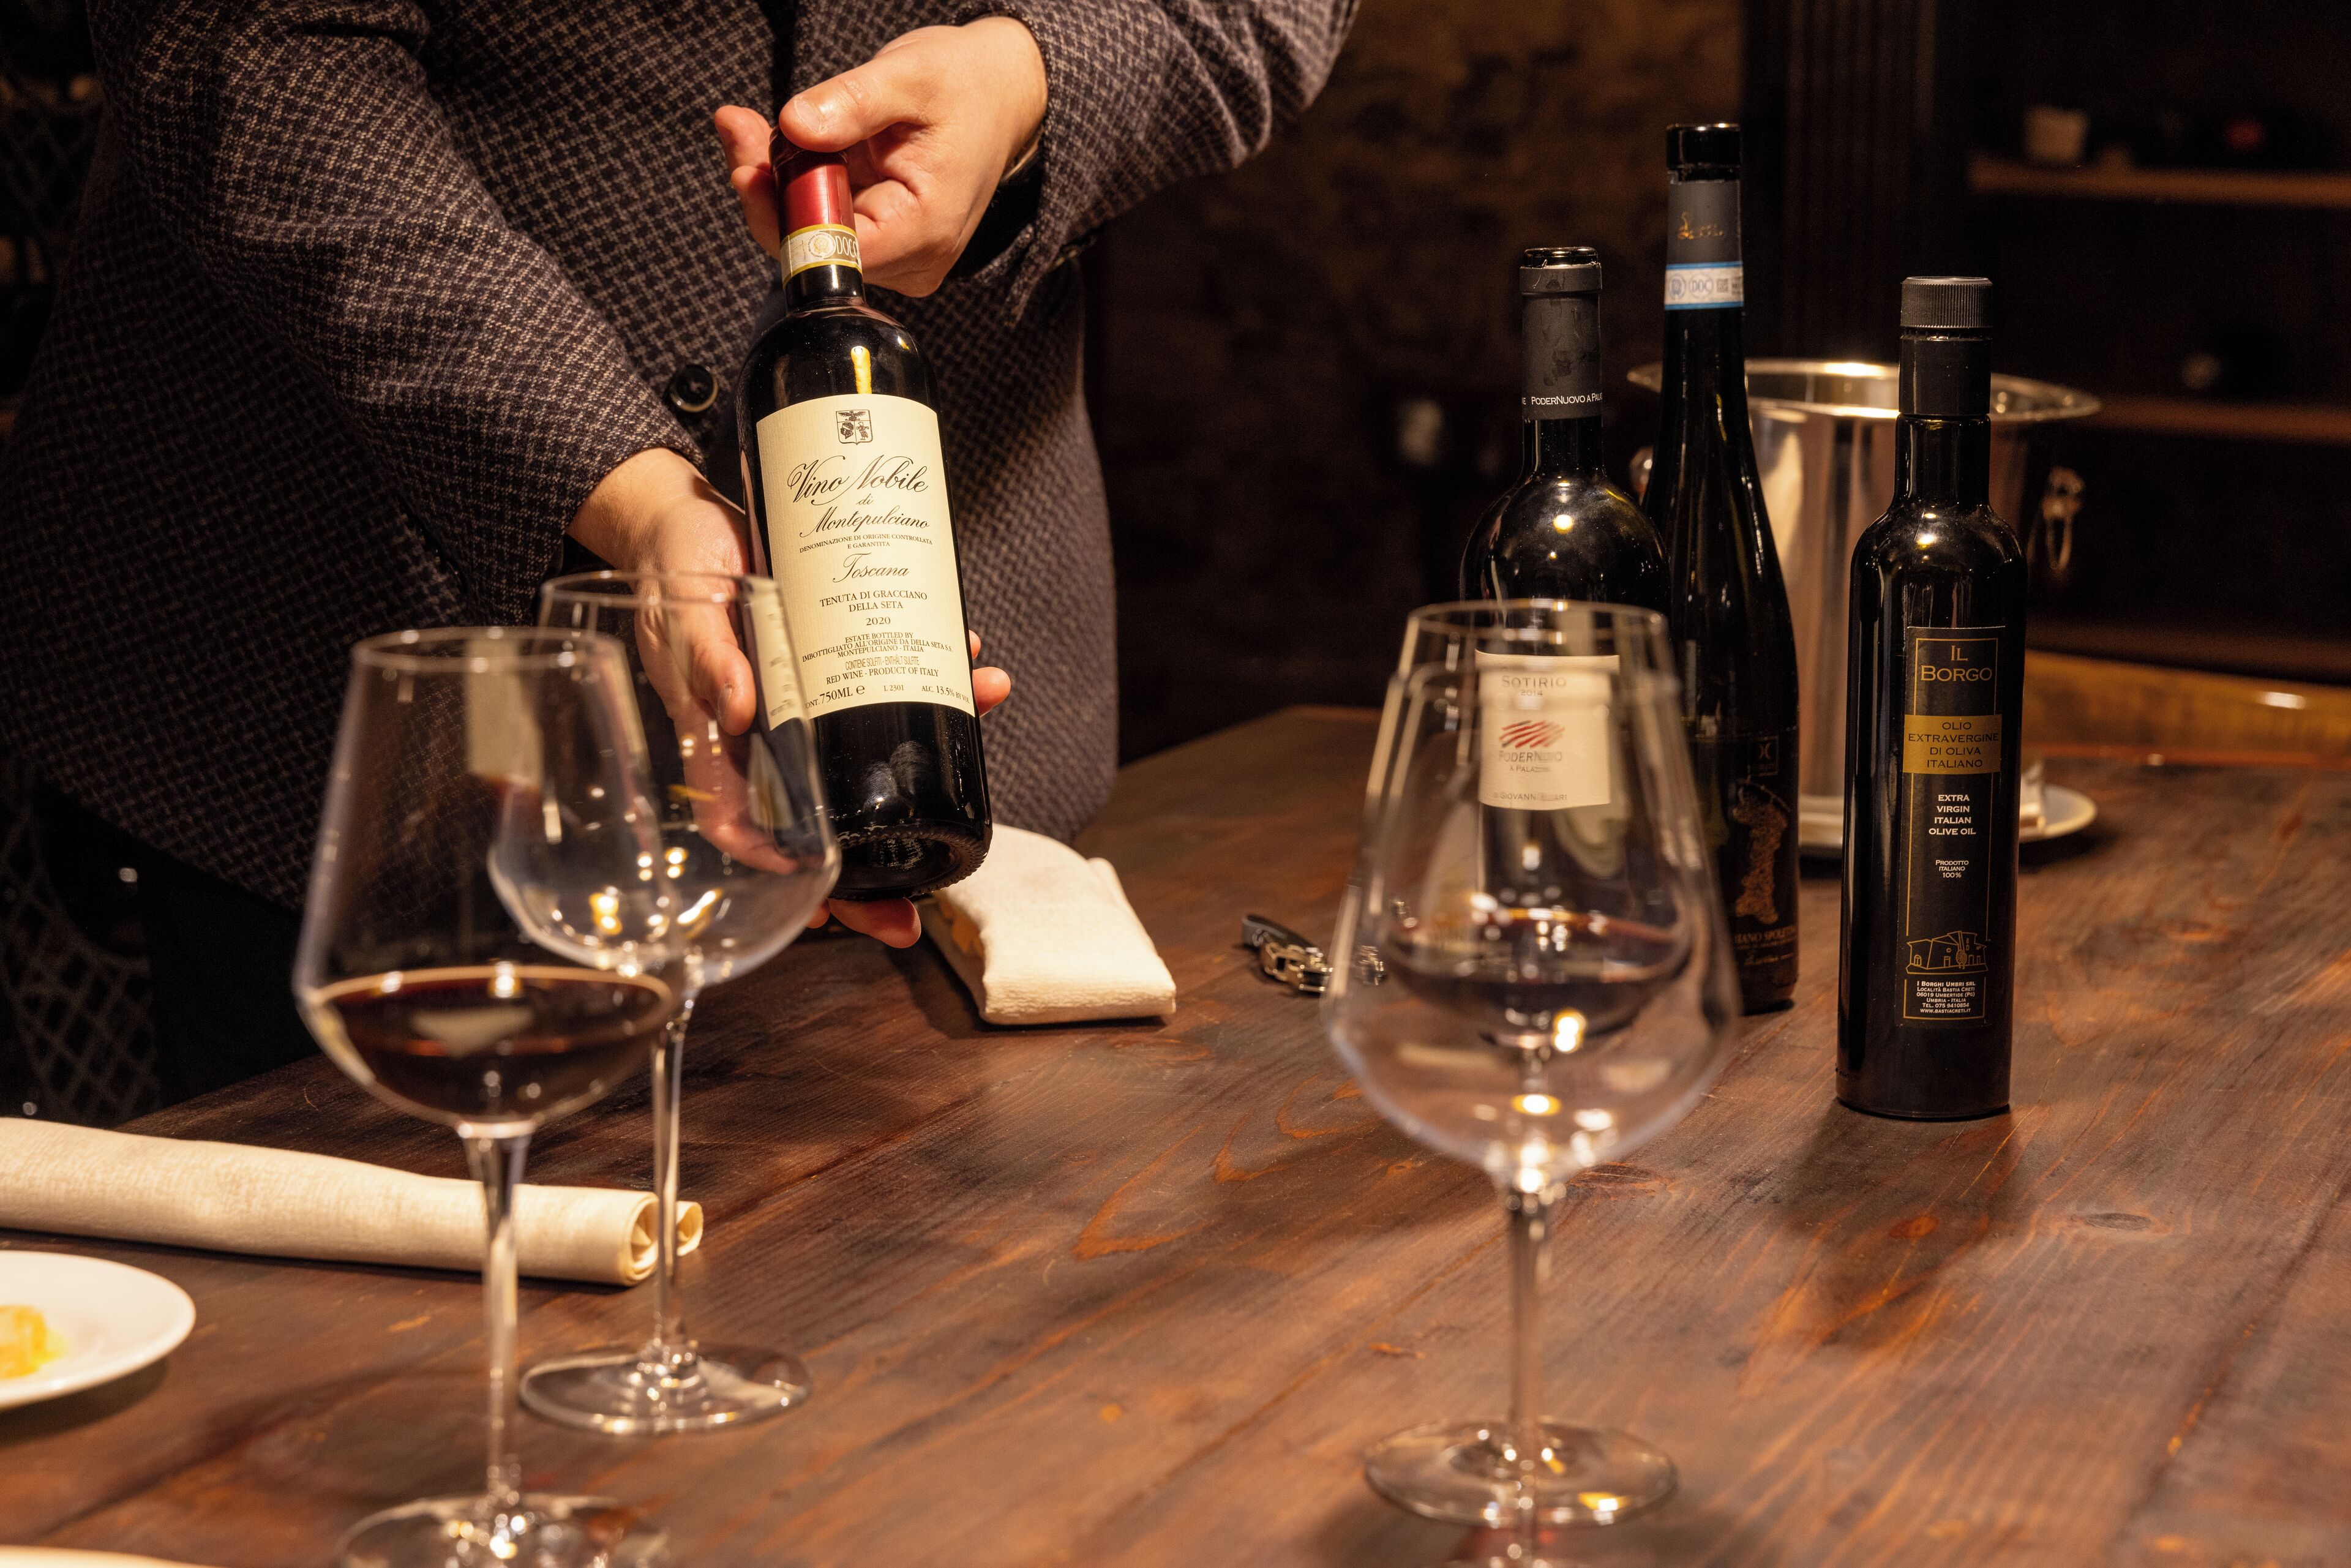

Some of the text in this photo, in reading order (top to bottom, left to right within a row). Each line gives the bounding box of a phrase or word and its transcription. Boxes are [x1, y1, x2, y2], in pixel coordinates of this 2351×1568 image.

[1692, 279, 1711, 293] DOC
[1531, 396, 1585, 405] PODERNUOVO
[787, 455, 849, 503] Vino
[856, 493, 874, 505] di
[800, 505, 930, 538] Montepulciano
[800, 536, 852, 553] DENOMINAZIONE
[891, 534, 933, 545] CONTROLLATA
[833, 552, 909, 583] Toscana
[820, 593, 857, 607] TENUTA
[873, 590, 928, 600] GRACCIANO
[849, 602, 879, 613] DELLA
[865, 617, 891, 626] 2020
[845, 634, 870, 643] ESTATE
[802, 643, 853, 662] IMBOTTIGLIATO
[855, 639, 898, 648] ALL'ORIGINE
[838, 645, 898, 658] MONTEPULCIANO
[1951, 645, 1968, 661] IL
[846, 659, 866, 670] CONTIENE
[867, 657, 882, 667] SOLFITI
[904, 656, 920, 666] SULFITE
[826, 675, 841, 685] RED
[842, 670, 863, 680] WINE
[869, 667, 906, 677] PRODUCT
[920, 667, 939, 677] ITALY
[1921, 665, 1993, 682] BORGO
[1501, 675, 1566, 688] SOTIRIO
[805, 699, 819, 708] ONT.
[819, 687, 853, 703] 750ML
[937, 685, 954, 697] 13.5%
[1908, 732, 1999, 743] EXTRAVERGINE
[1946, 747, 1981, 756] OLIVA
[1927, 759, 1982, 768] ITALIANO
[1500, 792, 1537, 800] GIOVANN
